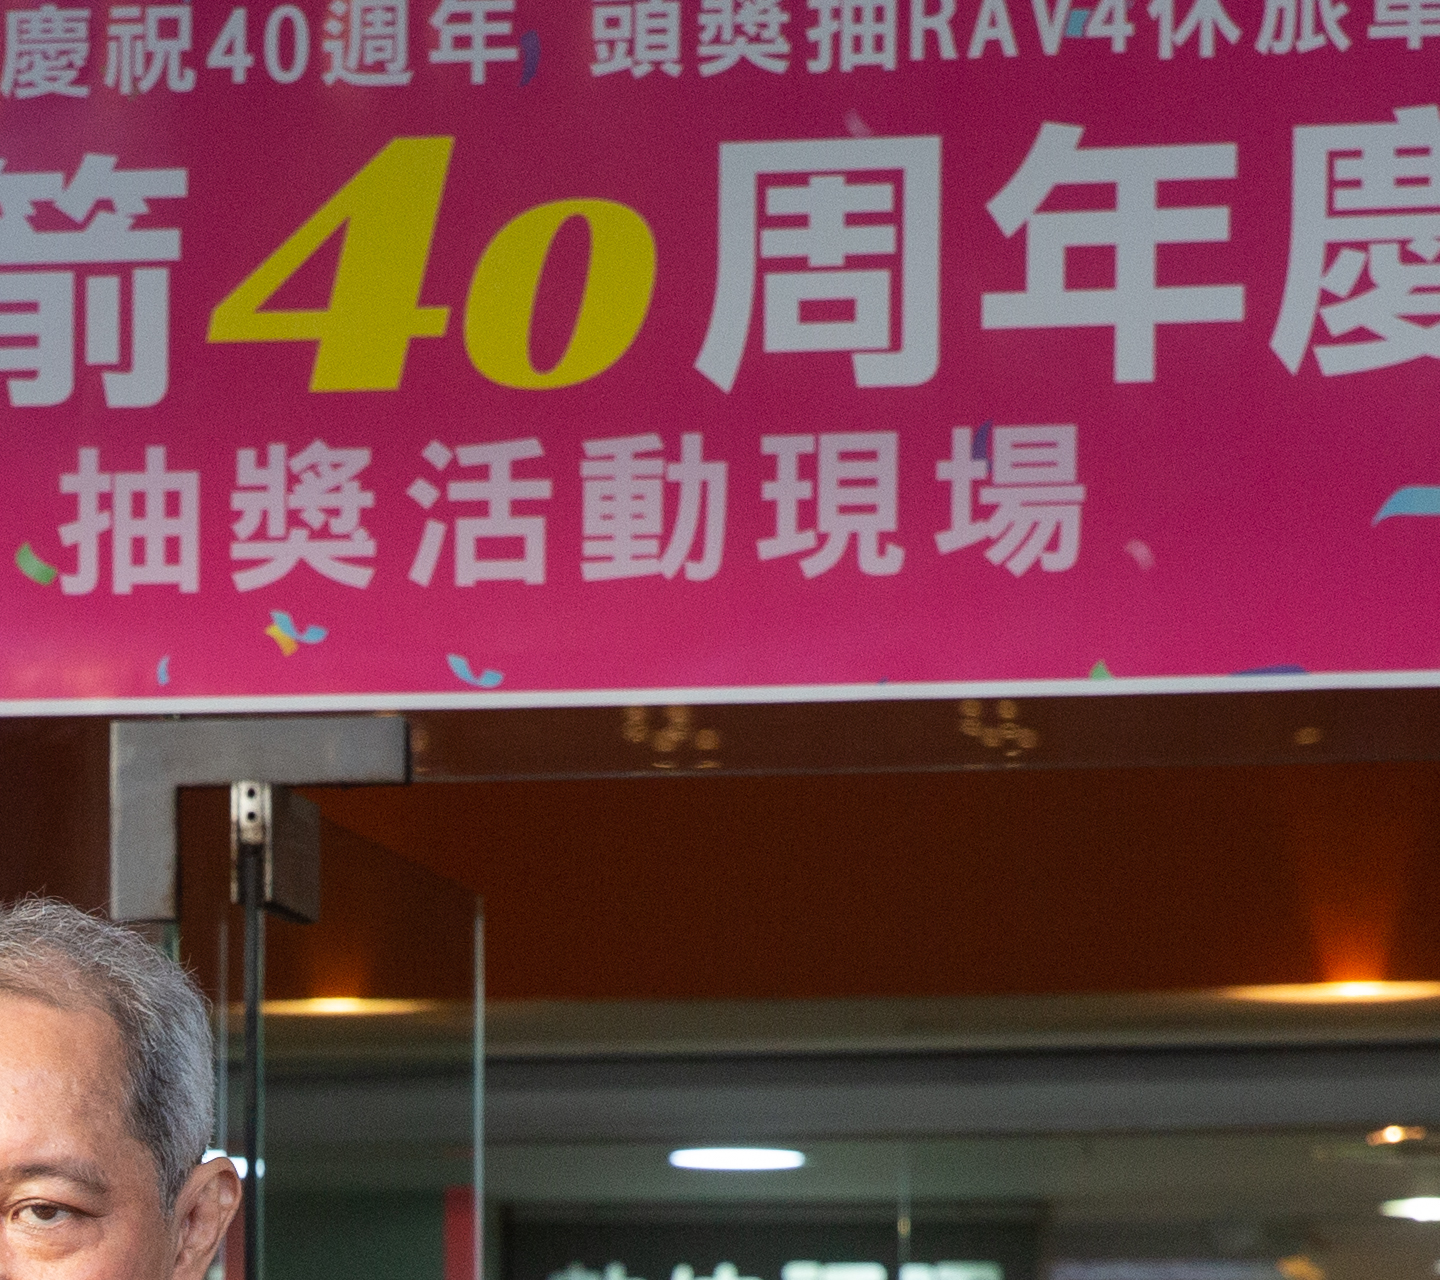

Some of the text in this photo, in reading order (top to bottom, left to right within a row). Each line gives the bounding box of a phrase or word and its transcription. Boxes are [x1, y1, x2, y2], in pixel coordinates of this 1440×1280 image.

[57, 424, 1086, 597] 抽獎活動現場
